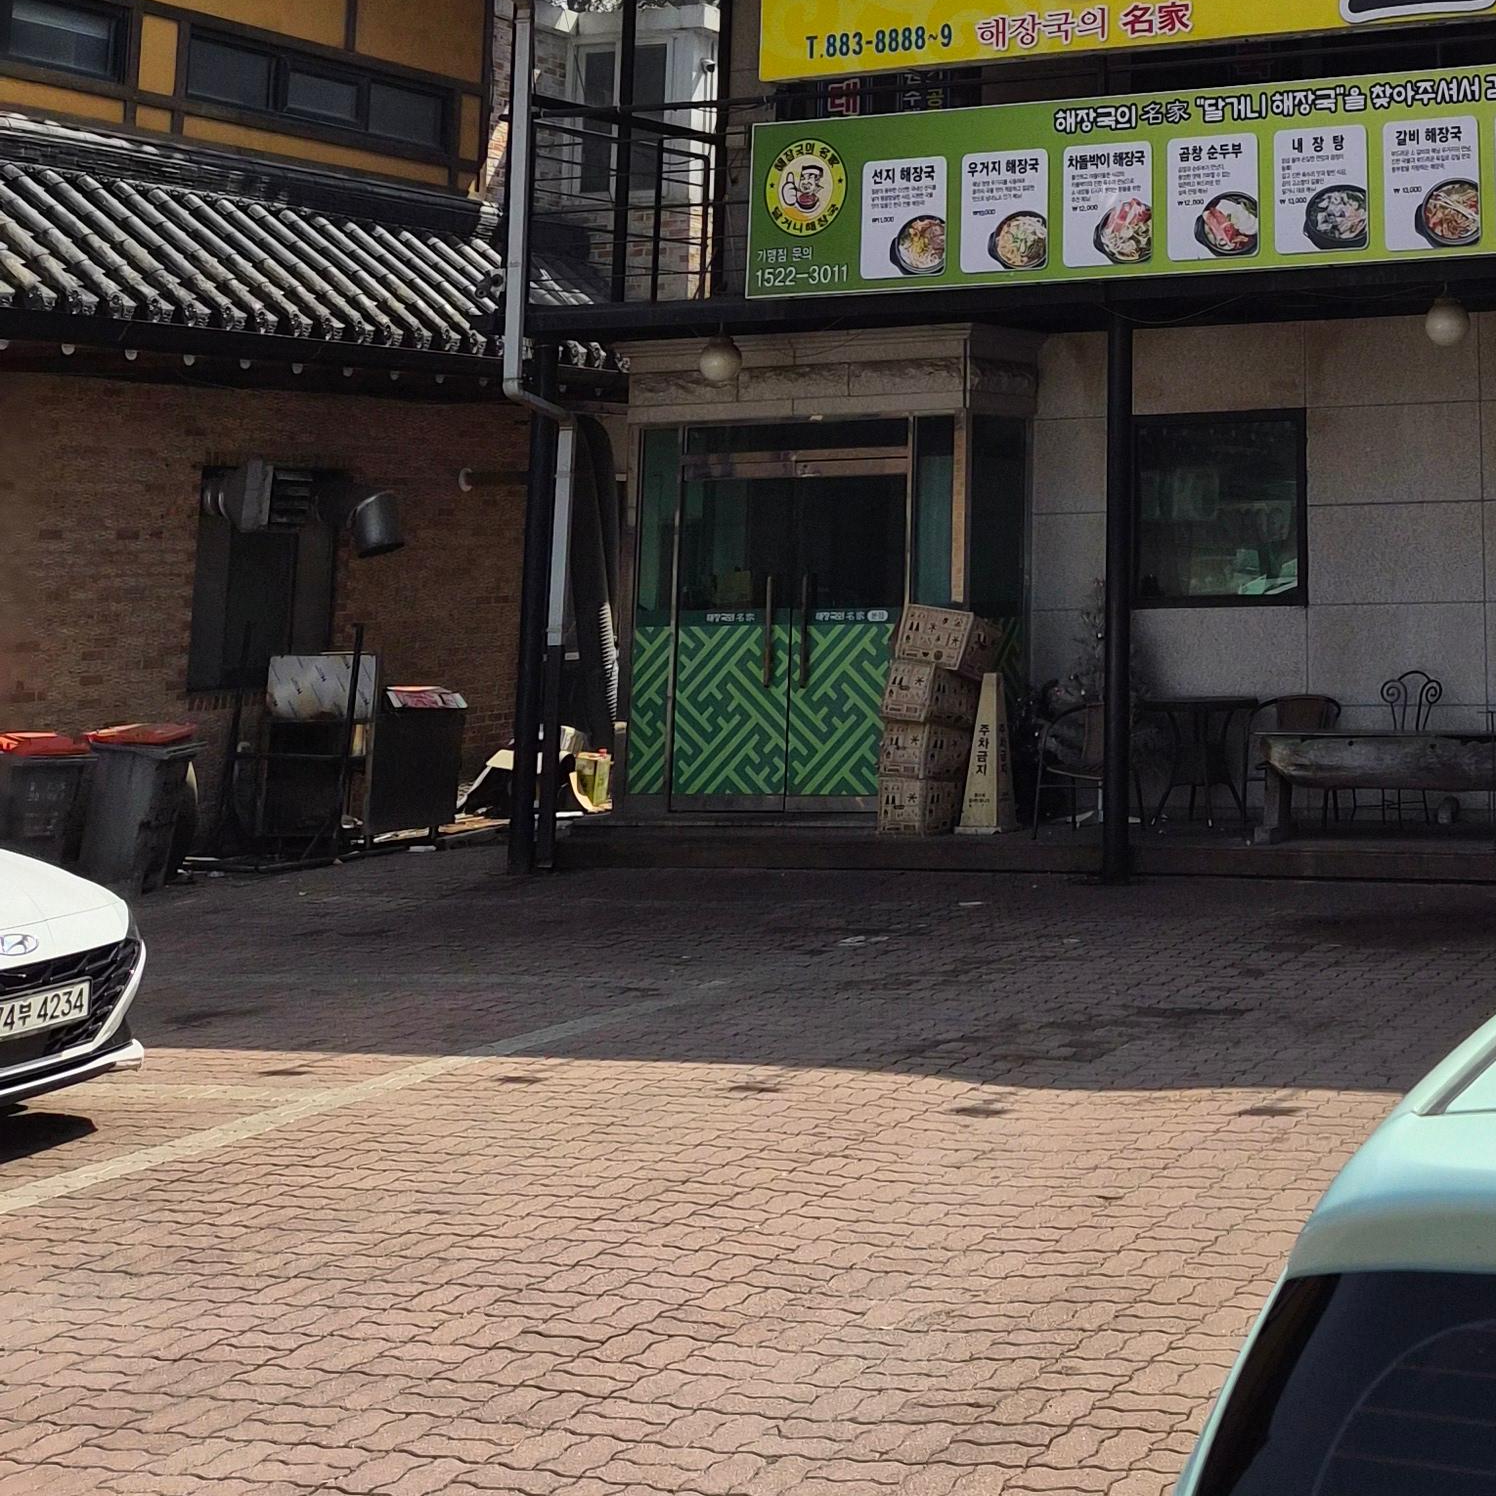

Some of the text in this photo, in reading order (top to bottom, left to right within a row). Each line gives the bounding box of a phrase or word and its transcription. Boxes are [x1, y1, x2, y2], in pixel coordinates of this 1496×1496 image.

[975, 0, 1193, 52] 해장국의 名家
[1054, 104, 1137, 134] 해장국의
[1140, 100, 1190, 125] 名家
[1370, 75, 1481, 110] 찾아주셔서
[1395, 126, 1462, 146] 갈비 해장국
[1068, 150, 1145, 170] 차돌박이 해장국
[1179, 143, 1242, 162] 곱창 순두부
[872, 165, 936, 184] 선지 해장국
[968, 158, 1040, 177] 우거지 해장국
[792, 246, 812, 261] 문의
[755, 265, 848, 288] 1522-3011
[975, 724, 990, 777] 주차금지
[0, 987, 84, 1031] 4부 4234
